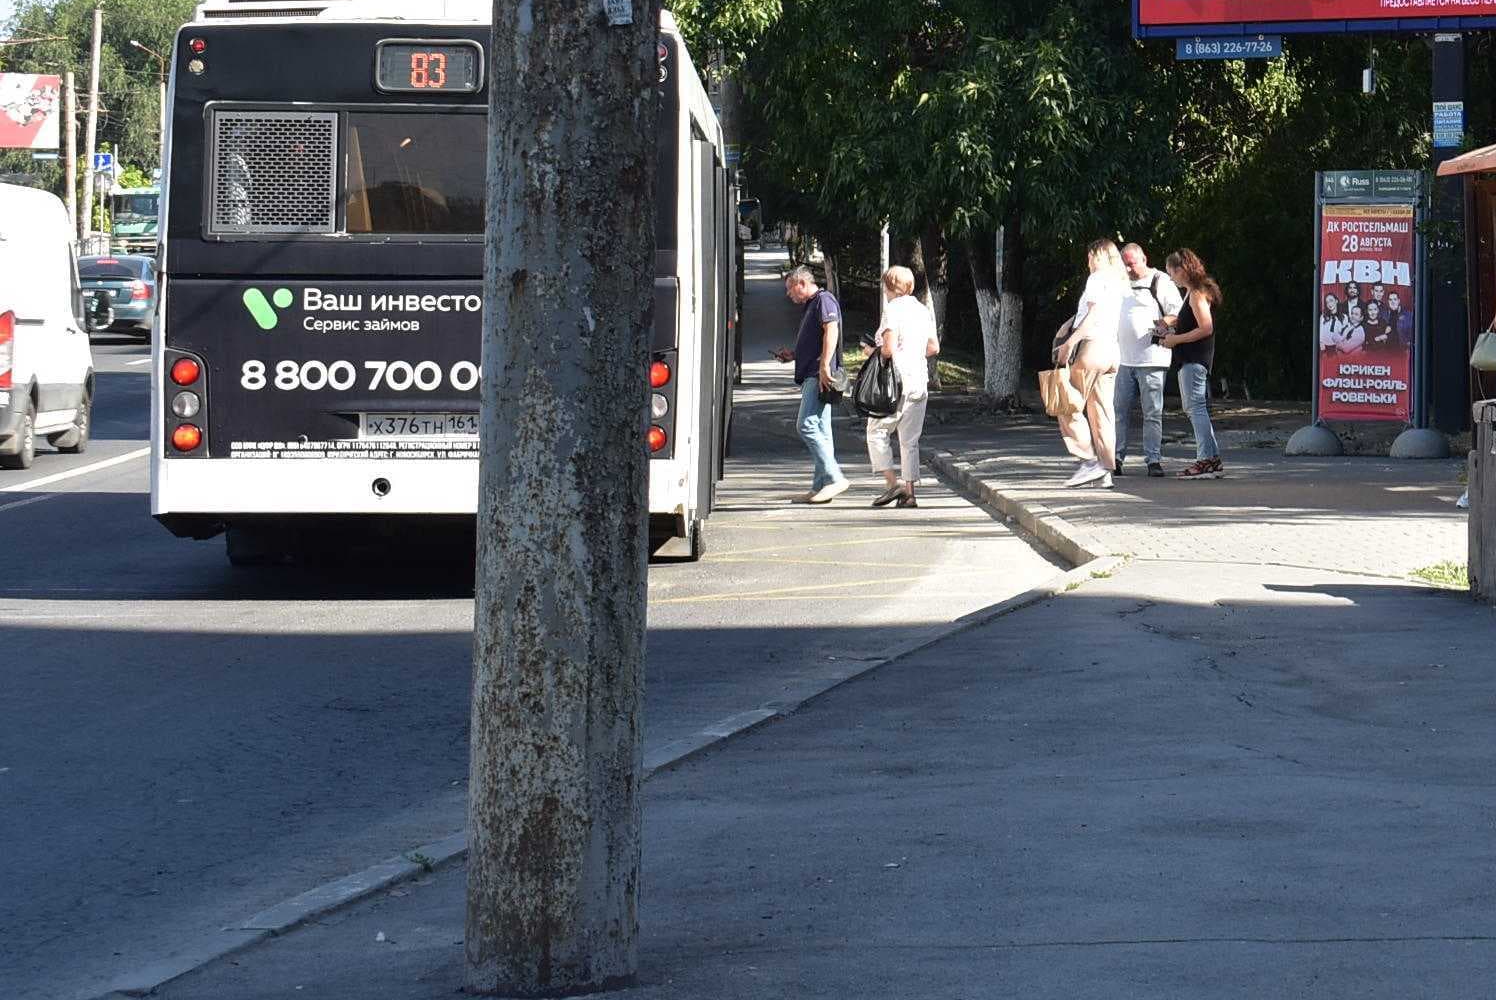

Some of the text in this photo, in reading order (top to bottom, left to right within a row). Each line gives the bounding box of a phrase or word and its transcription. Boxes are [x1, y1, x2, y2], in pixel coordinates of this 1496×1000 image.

[1186, 40, 1273, 55] 8 (863) 226-77-26
[411, 52, 446, 88] 83
[1327, 221, 1409, 233] ДК РОСТСЕЛЬМАШ
[1341, 234, 1359, 253] 28
[1360, 237, 1392, 248] АВГУСТА
[1322, 259, 1411, 286] КВН
[303, 288, 482, 312] Ваш инвесто
[303, 317, 420, 333] Сервис займов
[241, 360, 482, 391] 8 800 700 0
[1339, 364, 1391, 376] ЮРИКЕН
[1322, 378, 1408, 391] ФЛЭШ-РОЯЛЬ
[1332, 391, 1397, 404] РОВЕНЬКИ
